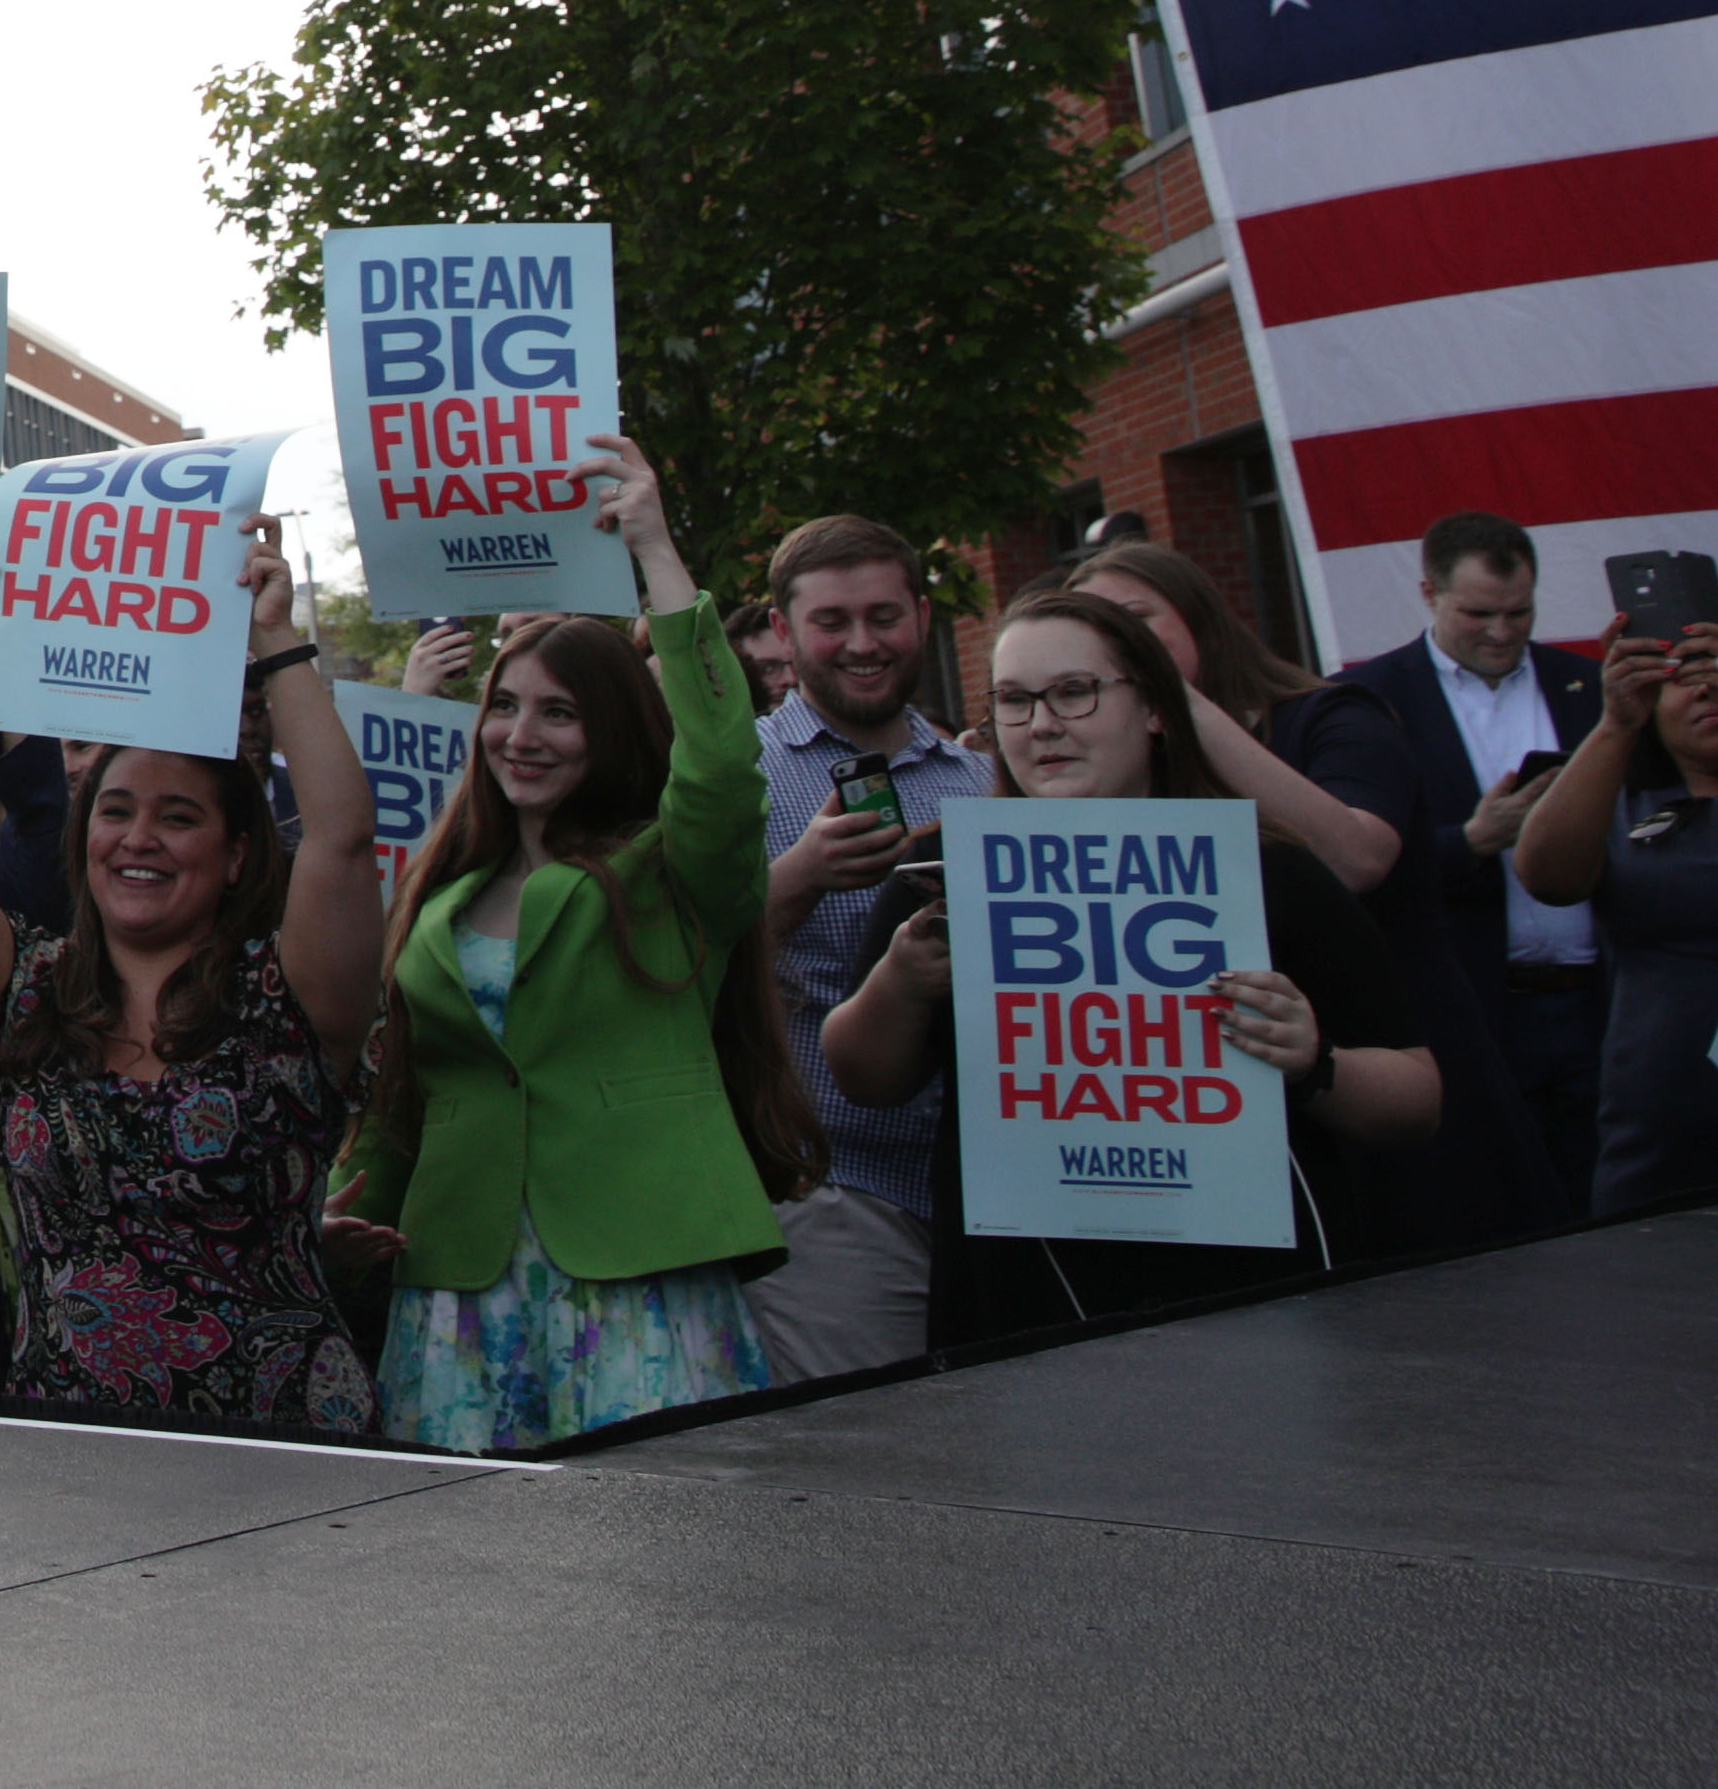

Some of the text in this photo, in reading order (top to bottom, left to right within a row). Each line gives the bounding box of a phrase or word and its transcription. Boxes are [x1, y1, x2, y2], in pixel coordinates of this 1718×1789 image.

[360, 256, 573, 314] DREAM
[363, 315, 577, 397] BIG
[369, 395, 580, 471] FIGHT
[22, 446, 237, 504] BIG
[380, 469, 588, 520] HARD
[6, 498, 221, 581] FIGHT
[439, 533, 552, 564] WARREN
[2, 571, 211, 635] HARD
[43, 644, 151, 686] WARREN
[363, 712, 467, 775] DREA
[365, 767, 444, 840] BI
[982, 834, 1219, 896] DREAM
[988, 900, 1229, 988] BIG
[995, 991, 1236, 1069] FIGHT
[999, 1072, 1244, 1125] HARD
[1059, 1145, 1188, 1180] WARREN
